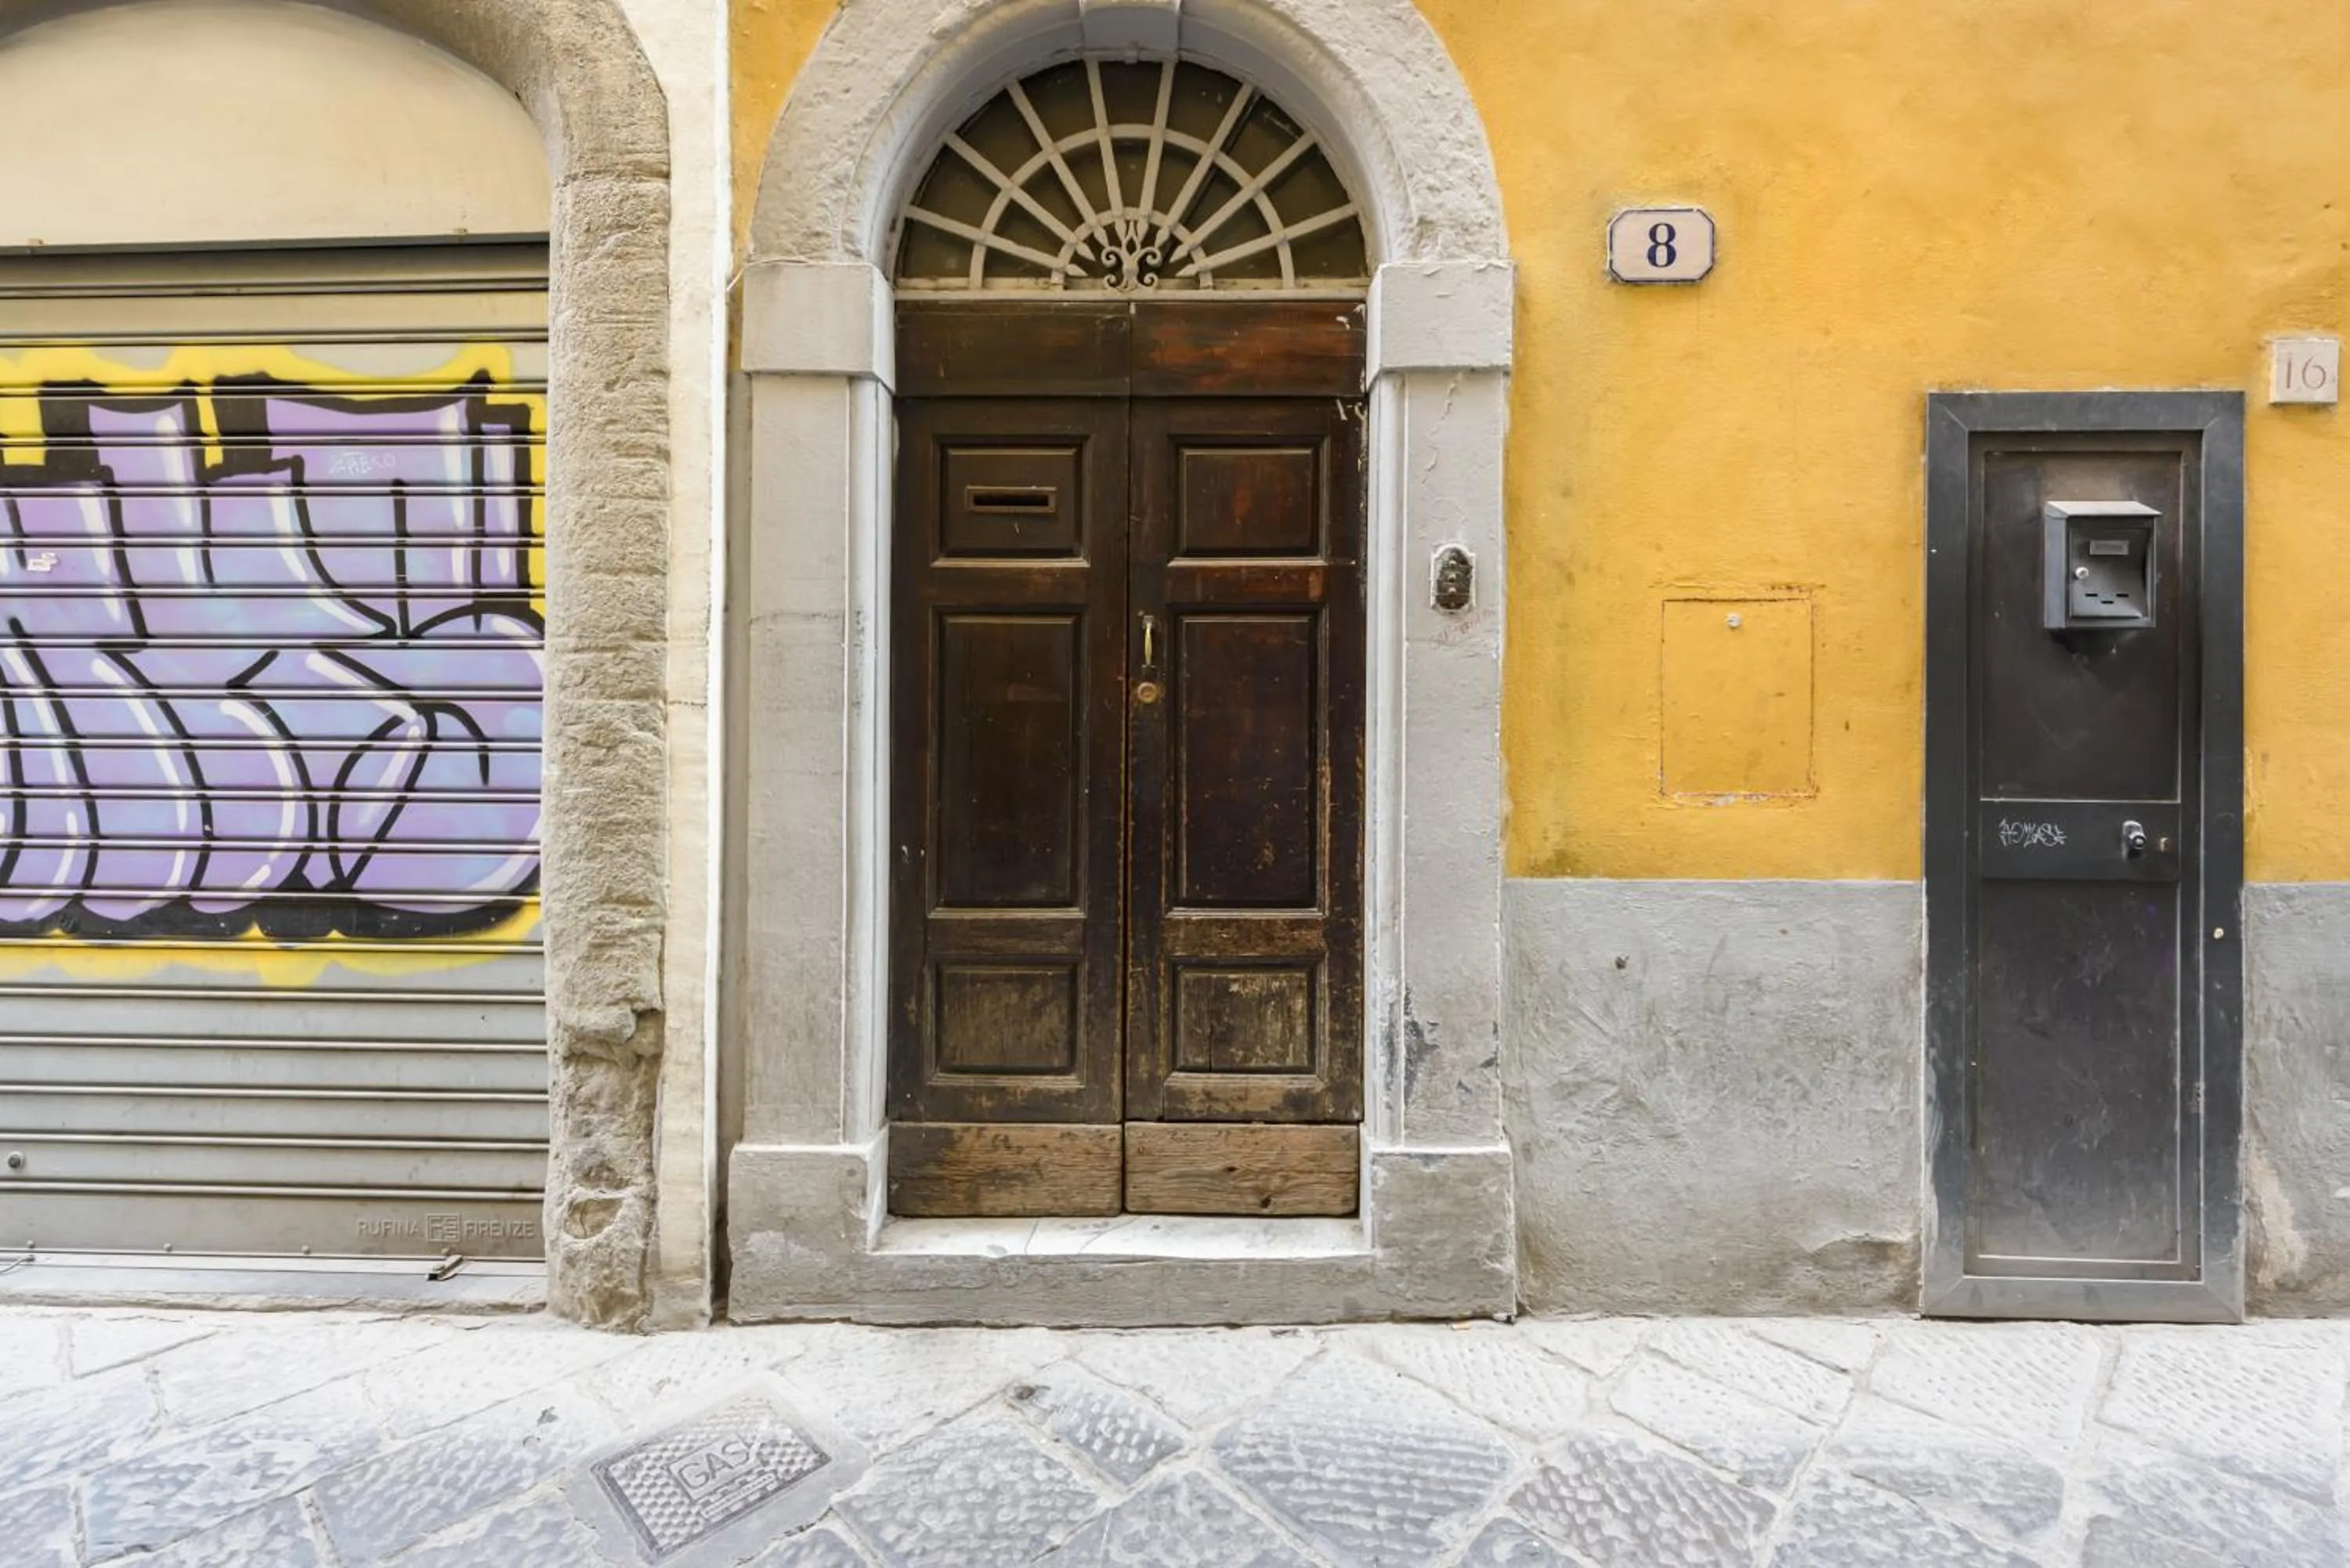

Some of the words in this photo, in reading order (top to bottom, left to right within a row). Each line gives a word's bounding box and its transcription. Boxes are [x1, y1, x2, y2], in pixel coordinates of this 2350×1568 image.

[1647, 222, 1676, 268] 8
[2286, 352, 2326, 391] 16
[464, 1219, 537, 1238] FIRENZE
[678, 1440, 750, 1489] GAS
